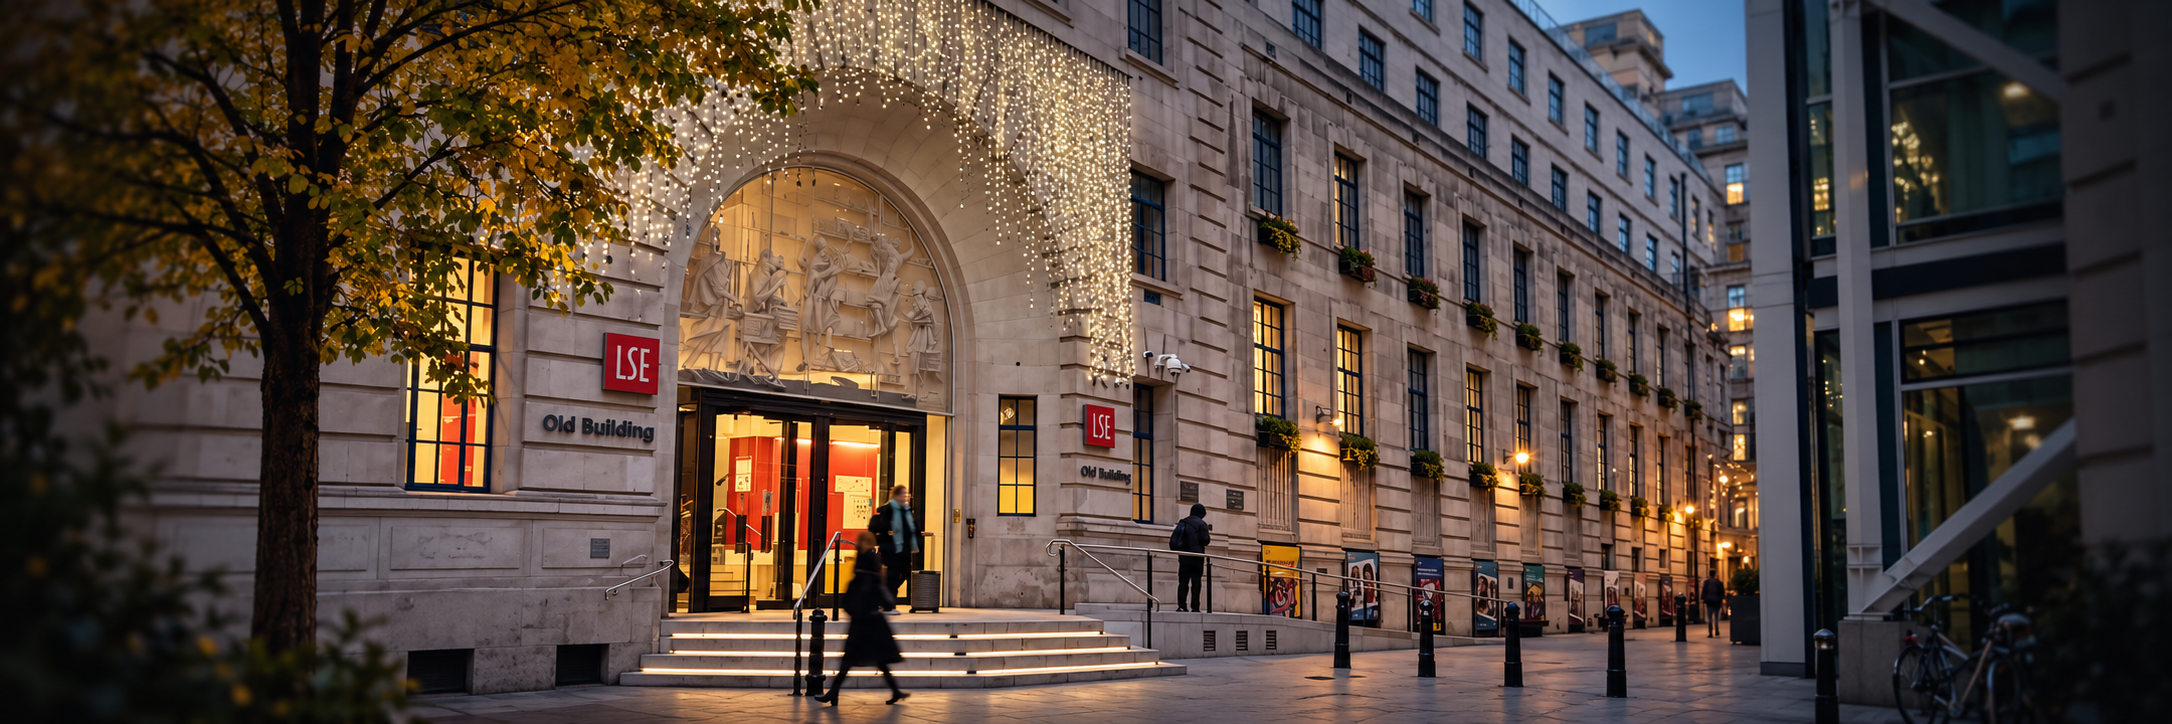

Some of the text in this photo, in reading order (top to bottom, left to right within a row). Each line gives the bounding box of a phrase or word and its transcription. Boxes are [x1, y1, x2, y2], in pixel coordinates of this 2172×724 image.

[616, 345, 650, 382] LSE
[543, 414, 654, 442] Old Building
[1092, 412, 1111, 440] LSE
[1081, 465, 1131, 485] Old Building
